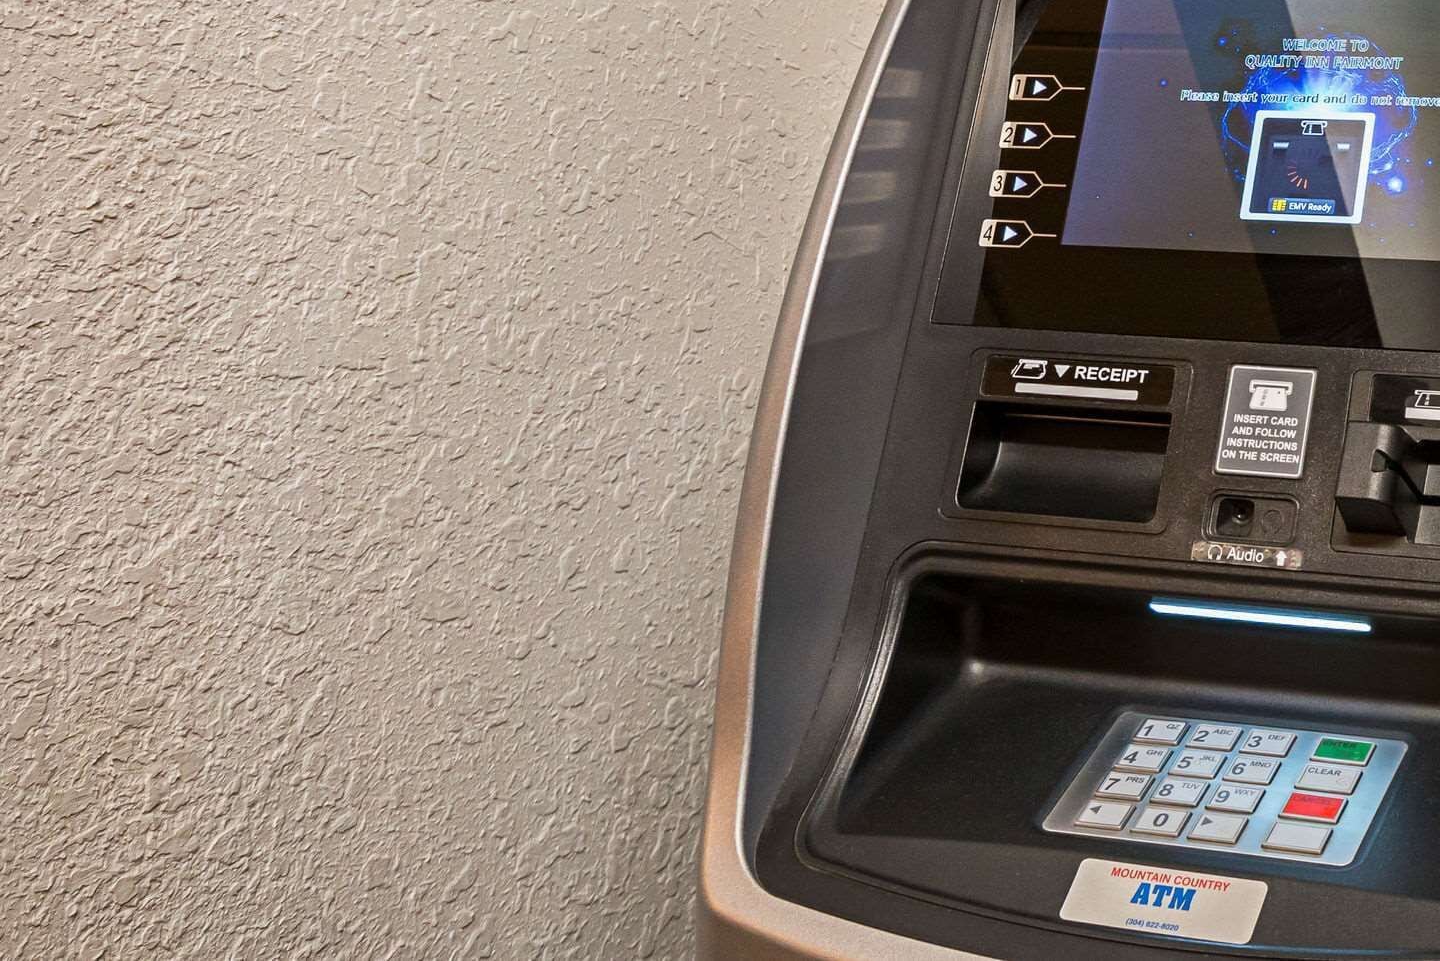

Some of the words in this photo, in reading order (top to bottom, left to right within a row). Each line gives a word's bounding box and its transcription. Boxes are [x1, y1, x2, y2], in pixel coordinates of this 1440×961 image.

[1282, 38, 1347, 51] WELCOME
[1351, 39, 1369, 52] TO
[1244, 54, 1303, 70] QUALITY
[1304, 55, 1330, 69] INN
[1333, 55, 1404, 70] FAIRMONT
[1015, 79, 1022, 92] 1
[1180, 89, 1219, 102] Please
[1222, 90, 1257, 103] insert
[1260, 93, 1289, 105] your
[1292, 93, 1320, 104] card
[1323, 93, 1347, 105] and
[1351, 93, 1367, 106] do
[1370, 95, 1393, 106] not
[1003, 127, 1013, 143] 2
[993, 176, 1003, 191] 3
[1288, 201, 1306, 211] EMV
[1307, 202, 1332, 213] Ready
[983, 225, 993, 241] 4
[1074, 366, 1149, 383] RECEIPT
[1233, 414, 1269, 424] INSERT
[1271, 416, 1298, 426] CARD
[1232, 426, 1253, 435] AND
[1255, 427, 1297, 438] FOLLOW
[1226, 438, 1298, 451] INSTRUCTIONS
[1222, 449, 1236, 459] ON
[1239, 450, 1258, 461] THE
[1259, 452, 1300, 463] SCREEN
[1226, 547, 1264, 563] Audio
[1143, 725, 1154, 736] 1
[1193, 730, 1210, 742] 2
[1212, 728, 1234, 736] ABC
[1247, 735, 1263, 748] 3
[1124, 751, 1138, 764] 4
[1177, 756, 1194, 769] 5
[1231, 762, 1247, 775] 6
[1307, 767, 1342, 776] CLEAR
[1104, 778, 1120, 790] 7
[1125, 776, 1145, 784] PRS
[1158, 783, 1174, 797] 8
[1182, 782, 1201, 790] TUV
[1215, 790, 1231, 803] 9
[1234, 788, 1256, 796] WXY
[1153, 813, 1169, 827] 0
[1111, 867, 1172, 884] MOUNTAIN
[1173, 876, 1231, 892] COUNTRY
[1130, 882, 1197, 911] ATM
[1125, 918, 1145, 927] (304)
